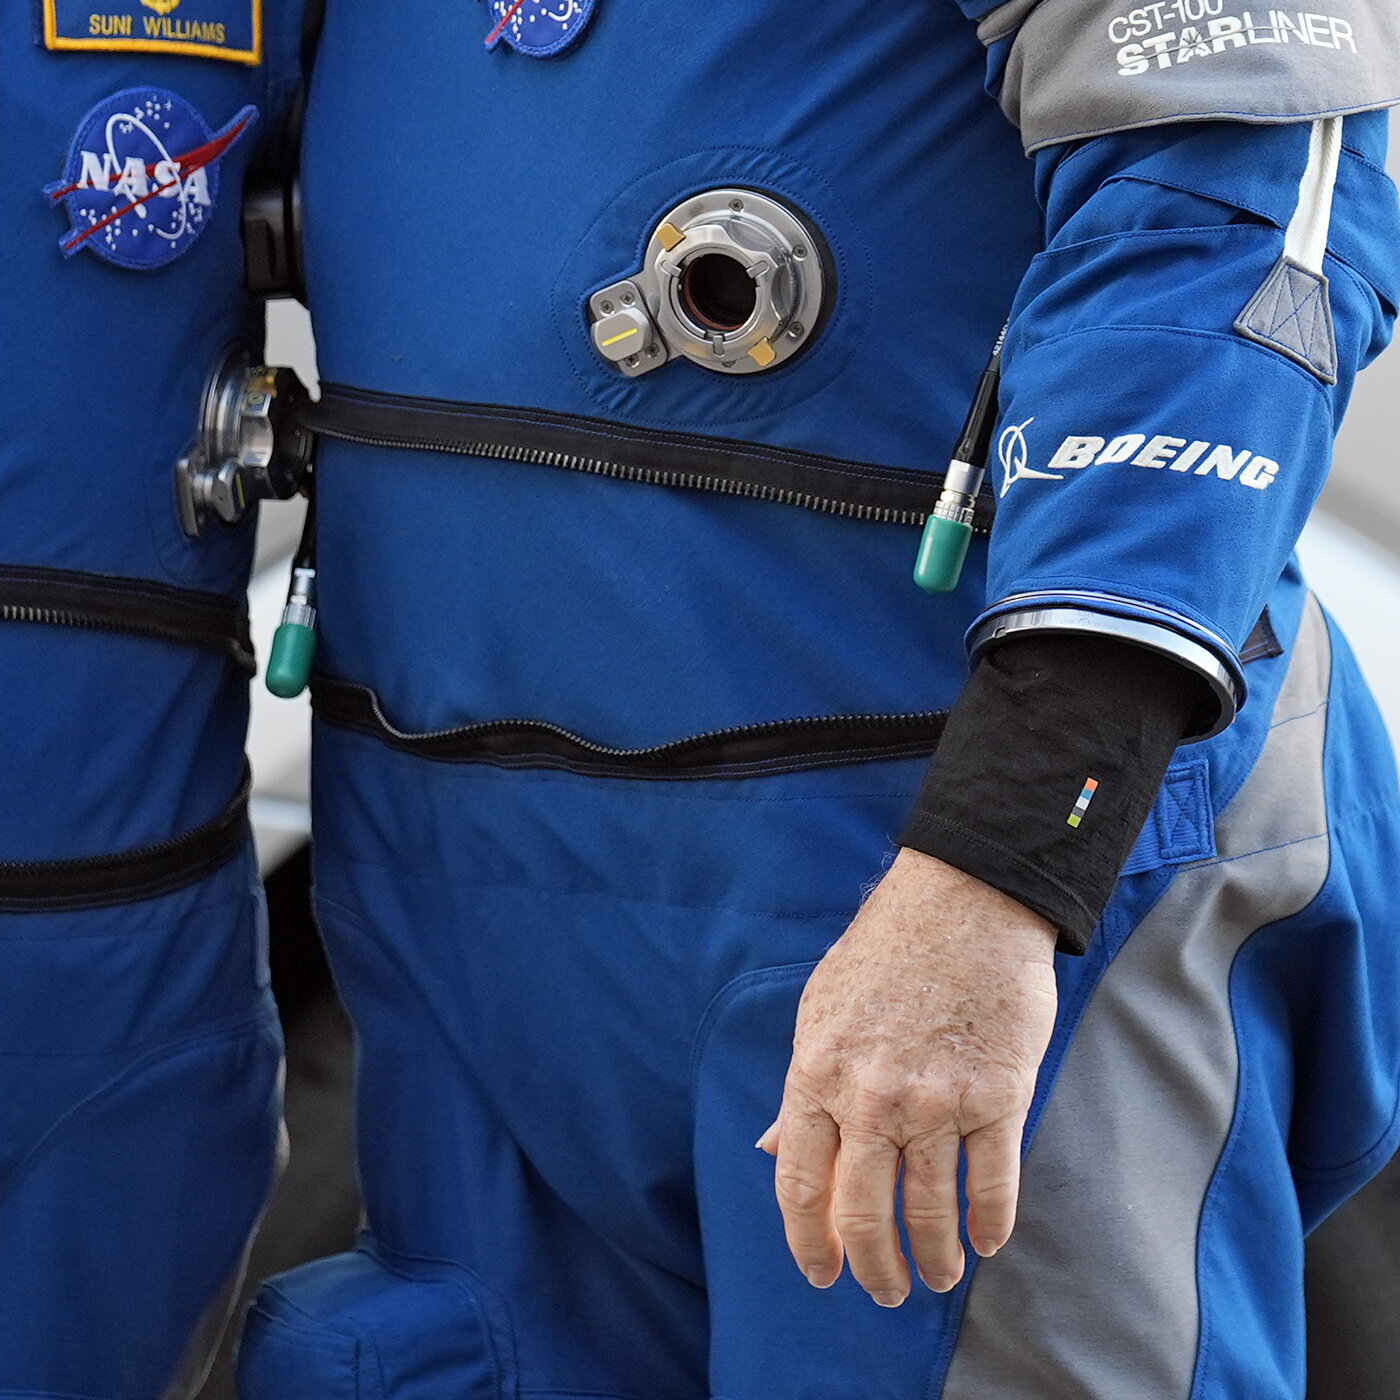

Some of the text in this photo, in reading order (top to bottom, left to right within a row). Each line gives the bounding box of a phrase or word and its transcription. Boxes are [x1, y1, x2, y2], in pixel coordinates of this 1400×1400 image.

[89, 14, 225, 44] SUNI WILLIAMS
[1116, 10, 1358, 76] STARLINER
[77, 150, 211, 206] NASA
[1047, 433, 1280, 490] BOEING
